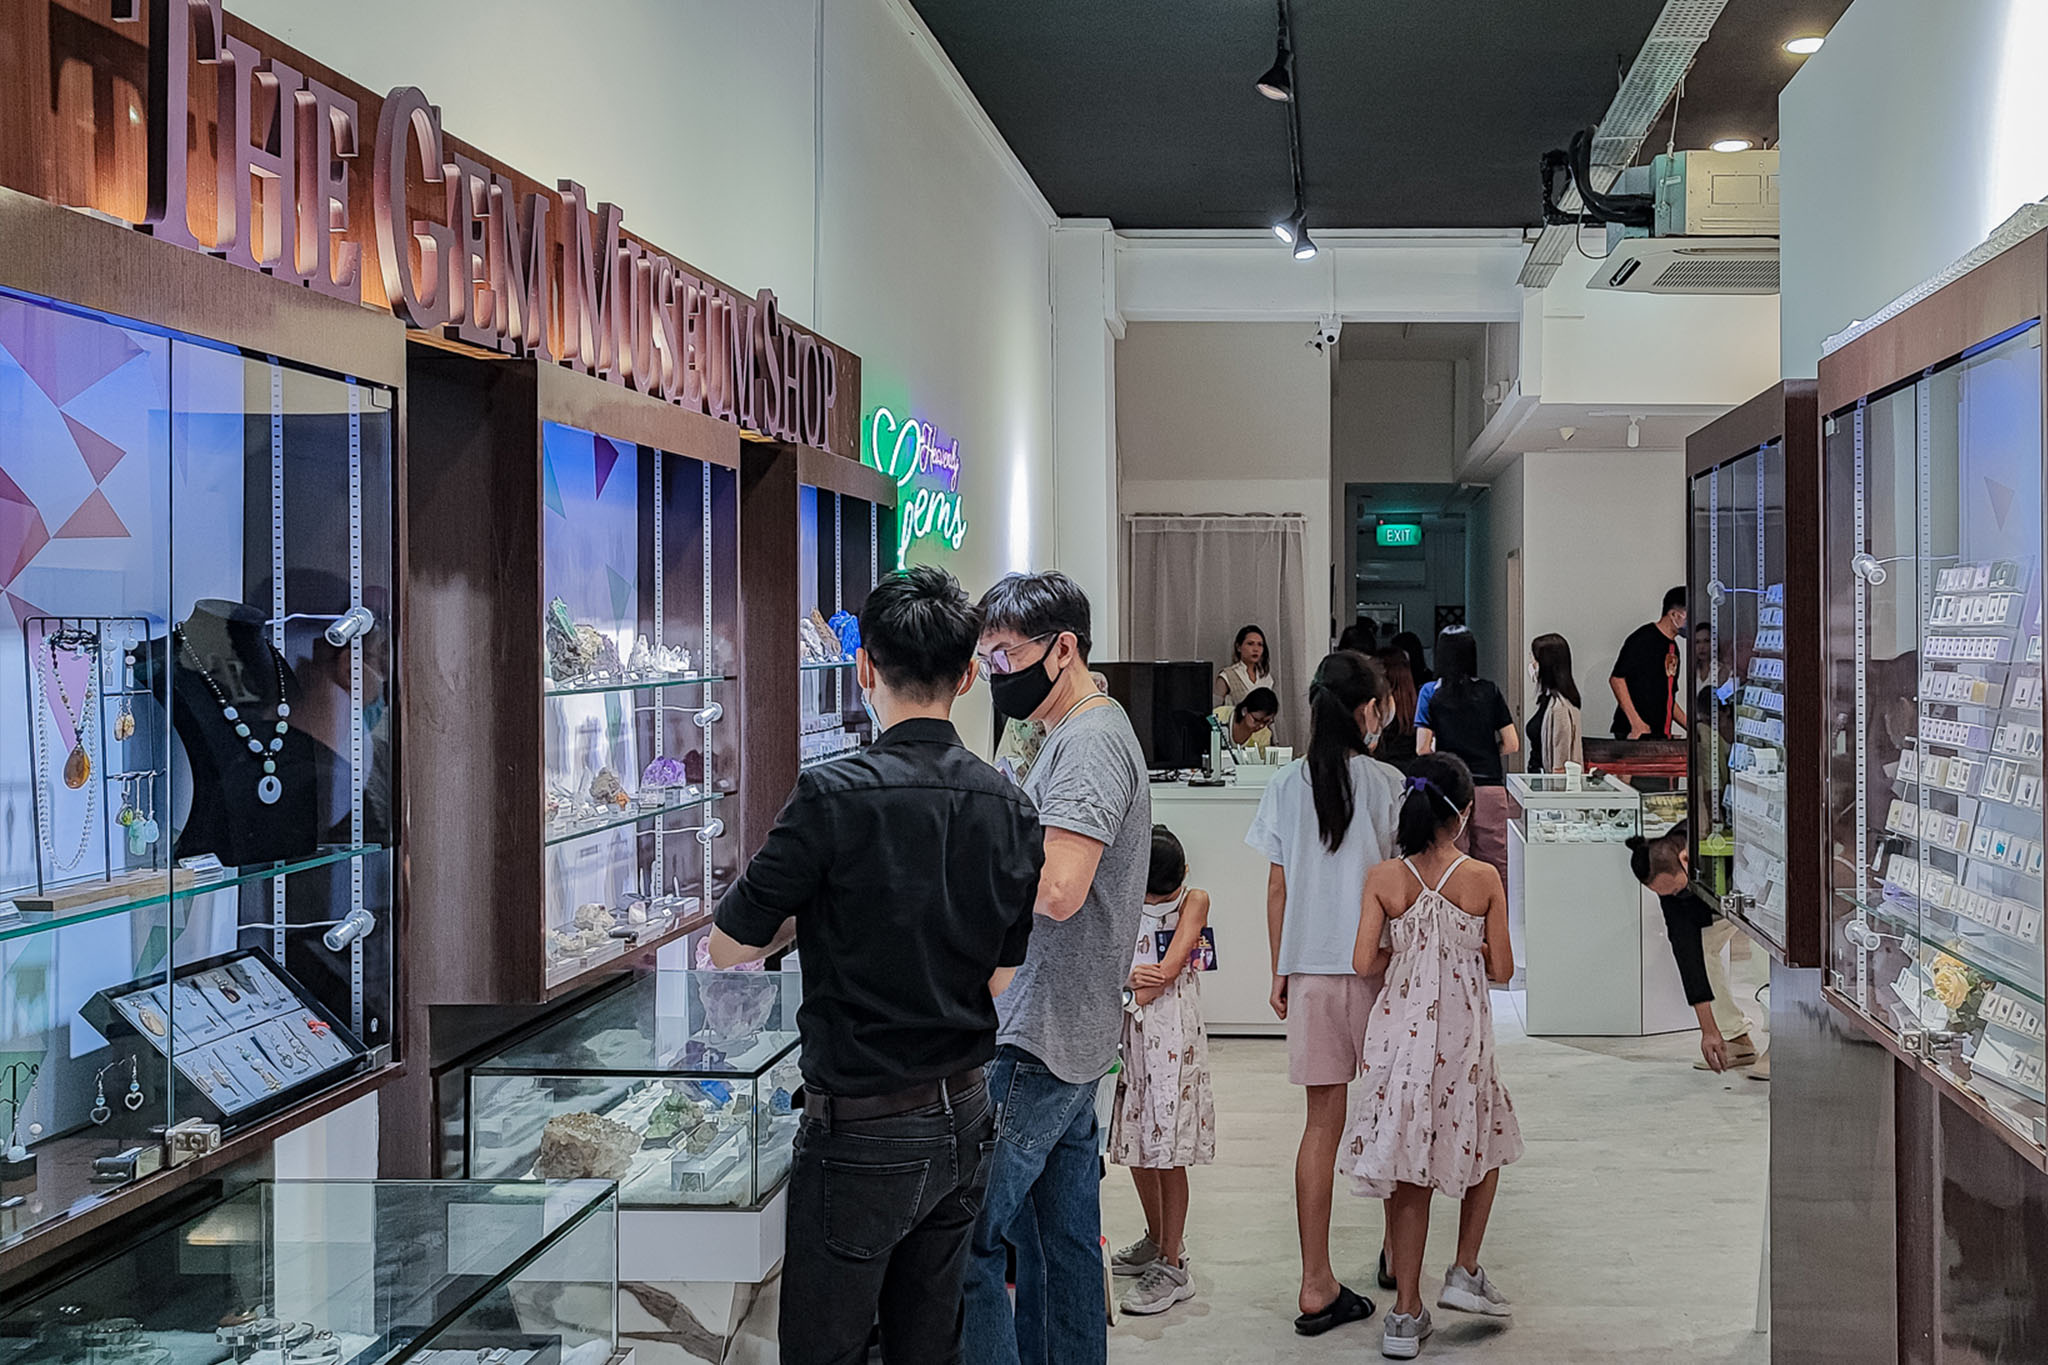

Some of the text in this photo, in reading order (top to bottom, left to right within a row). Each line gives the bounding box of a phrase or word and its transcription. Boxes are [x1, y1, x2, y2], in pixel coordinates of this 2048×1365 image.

[112, 0, 838, 452] THE GEM MUSEUM SHOP
[1387, 529, 1410, 541] EXIT
